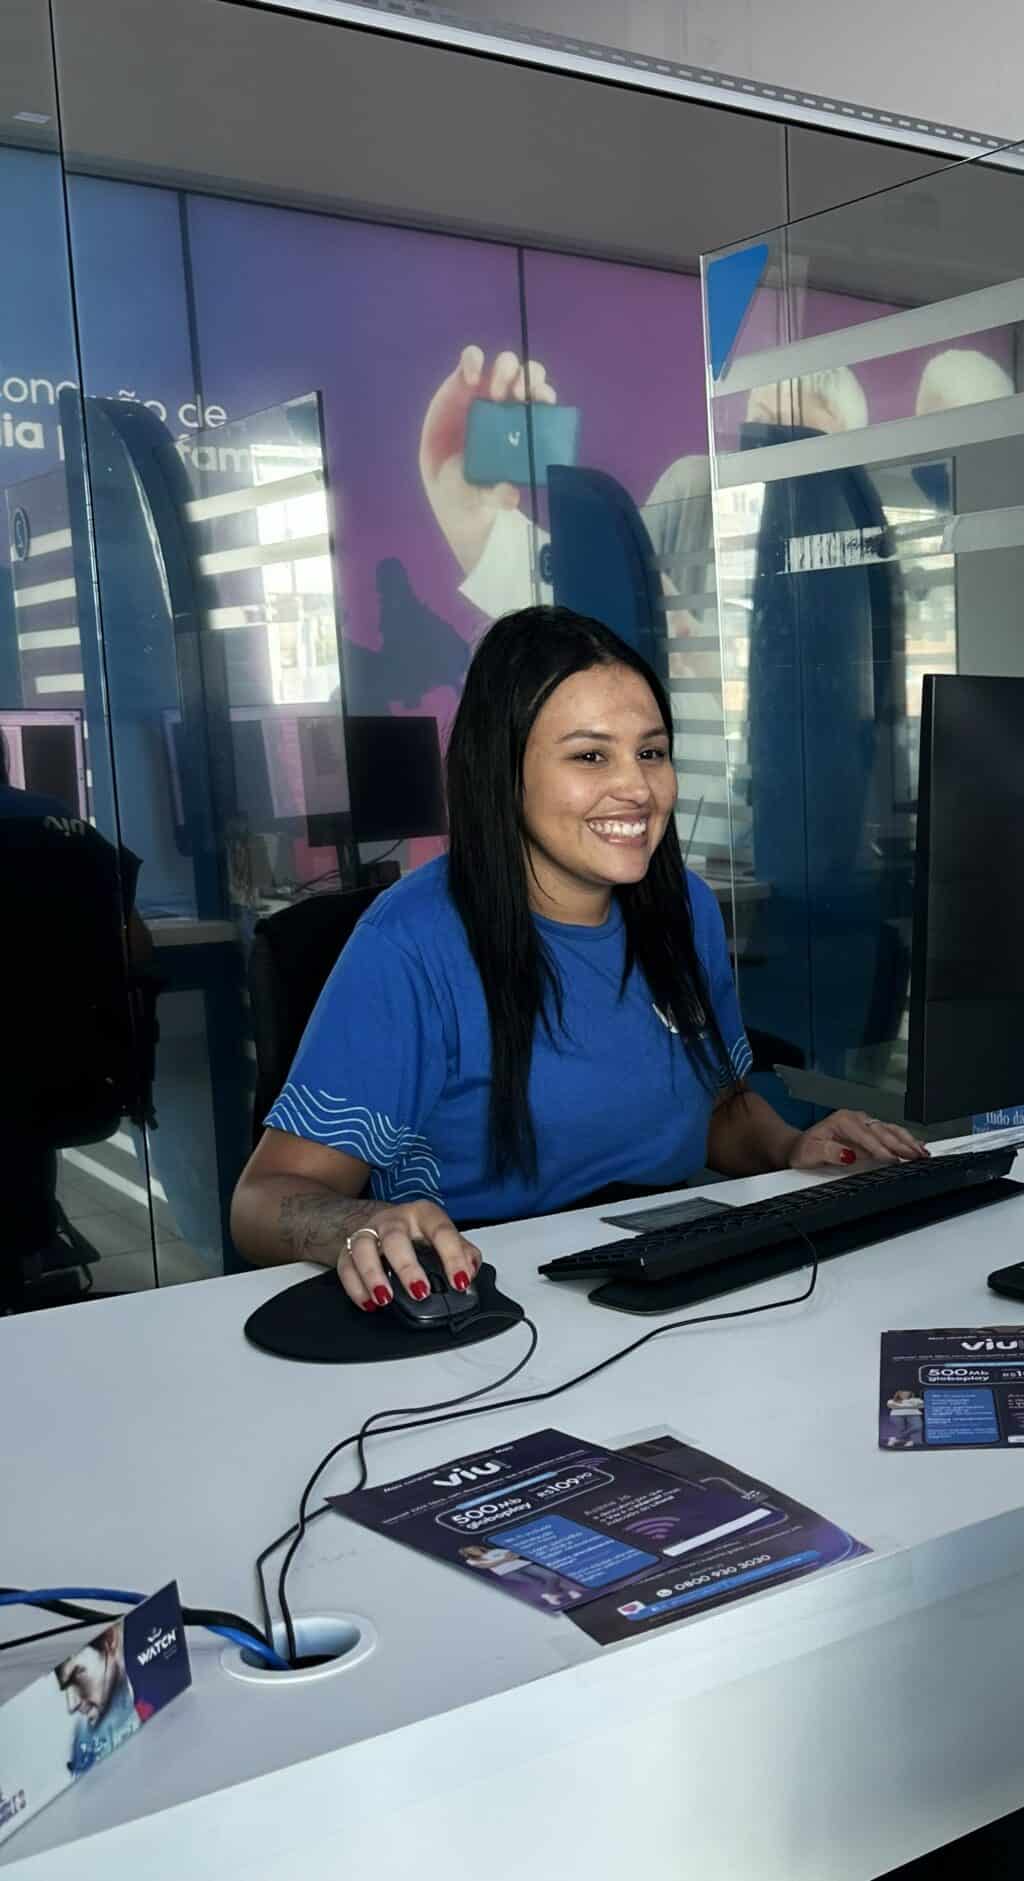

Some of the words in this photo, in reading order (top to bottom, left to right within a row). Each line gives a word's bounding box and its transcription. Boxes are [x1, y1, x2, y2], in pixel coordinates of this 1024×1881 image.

[178, 393, 228, 429] de
[0, 412, 45, 450] ia
[137, 1627, 176, 1667] WATCH
